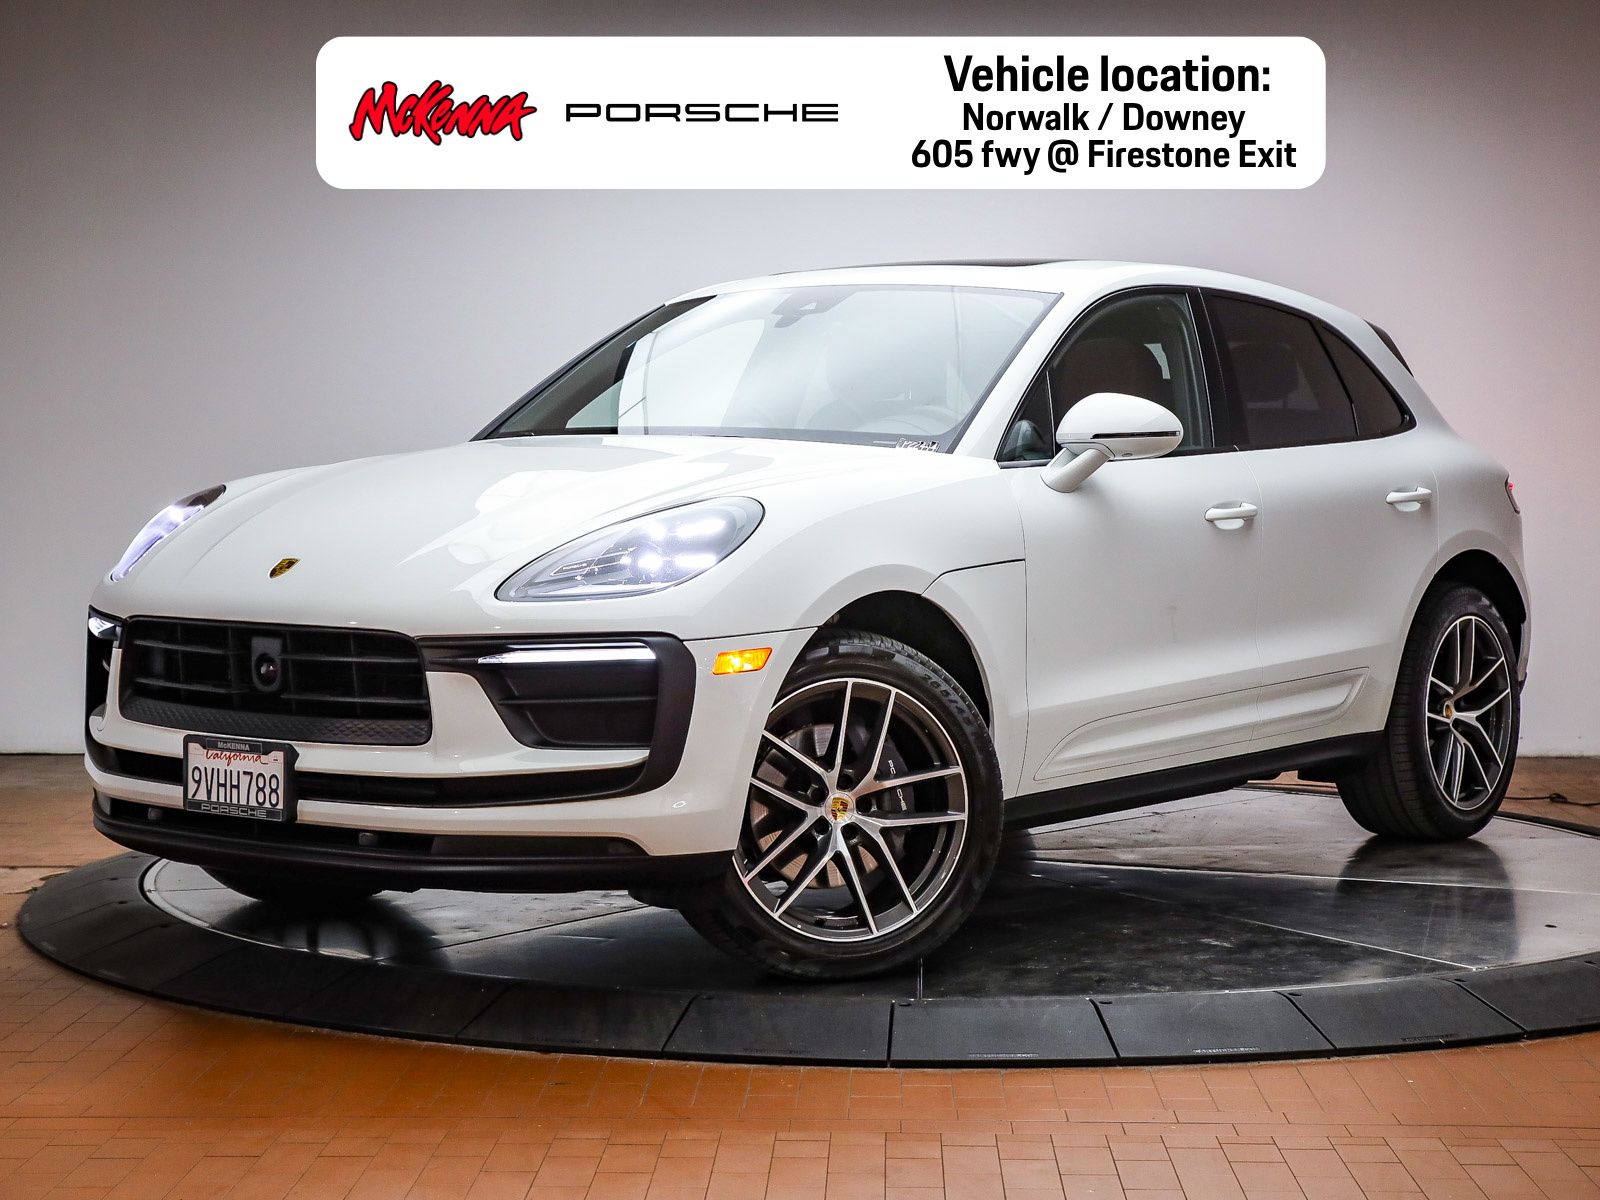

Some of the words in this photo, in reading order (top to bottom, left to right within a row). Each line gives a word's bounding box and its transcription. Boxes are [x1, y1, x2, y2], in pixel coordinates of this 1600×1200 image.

[217, 741, 250, 751] McKENNA
[191, 766, 280, 807] 9VHH788
[888, 760, 907, 811] POCHE
[201, 803, 267, 818] PORSCHE
